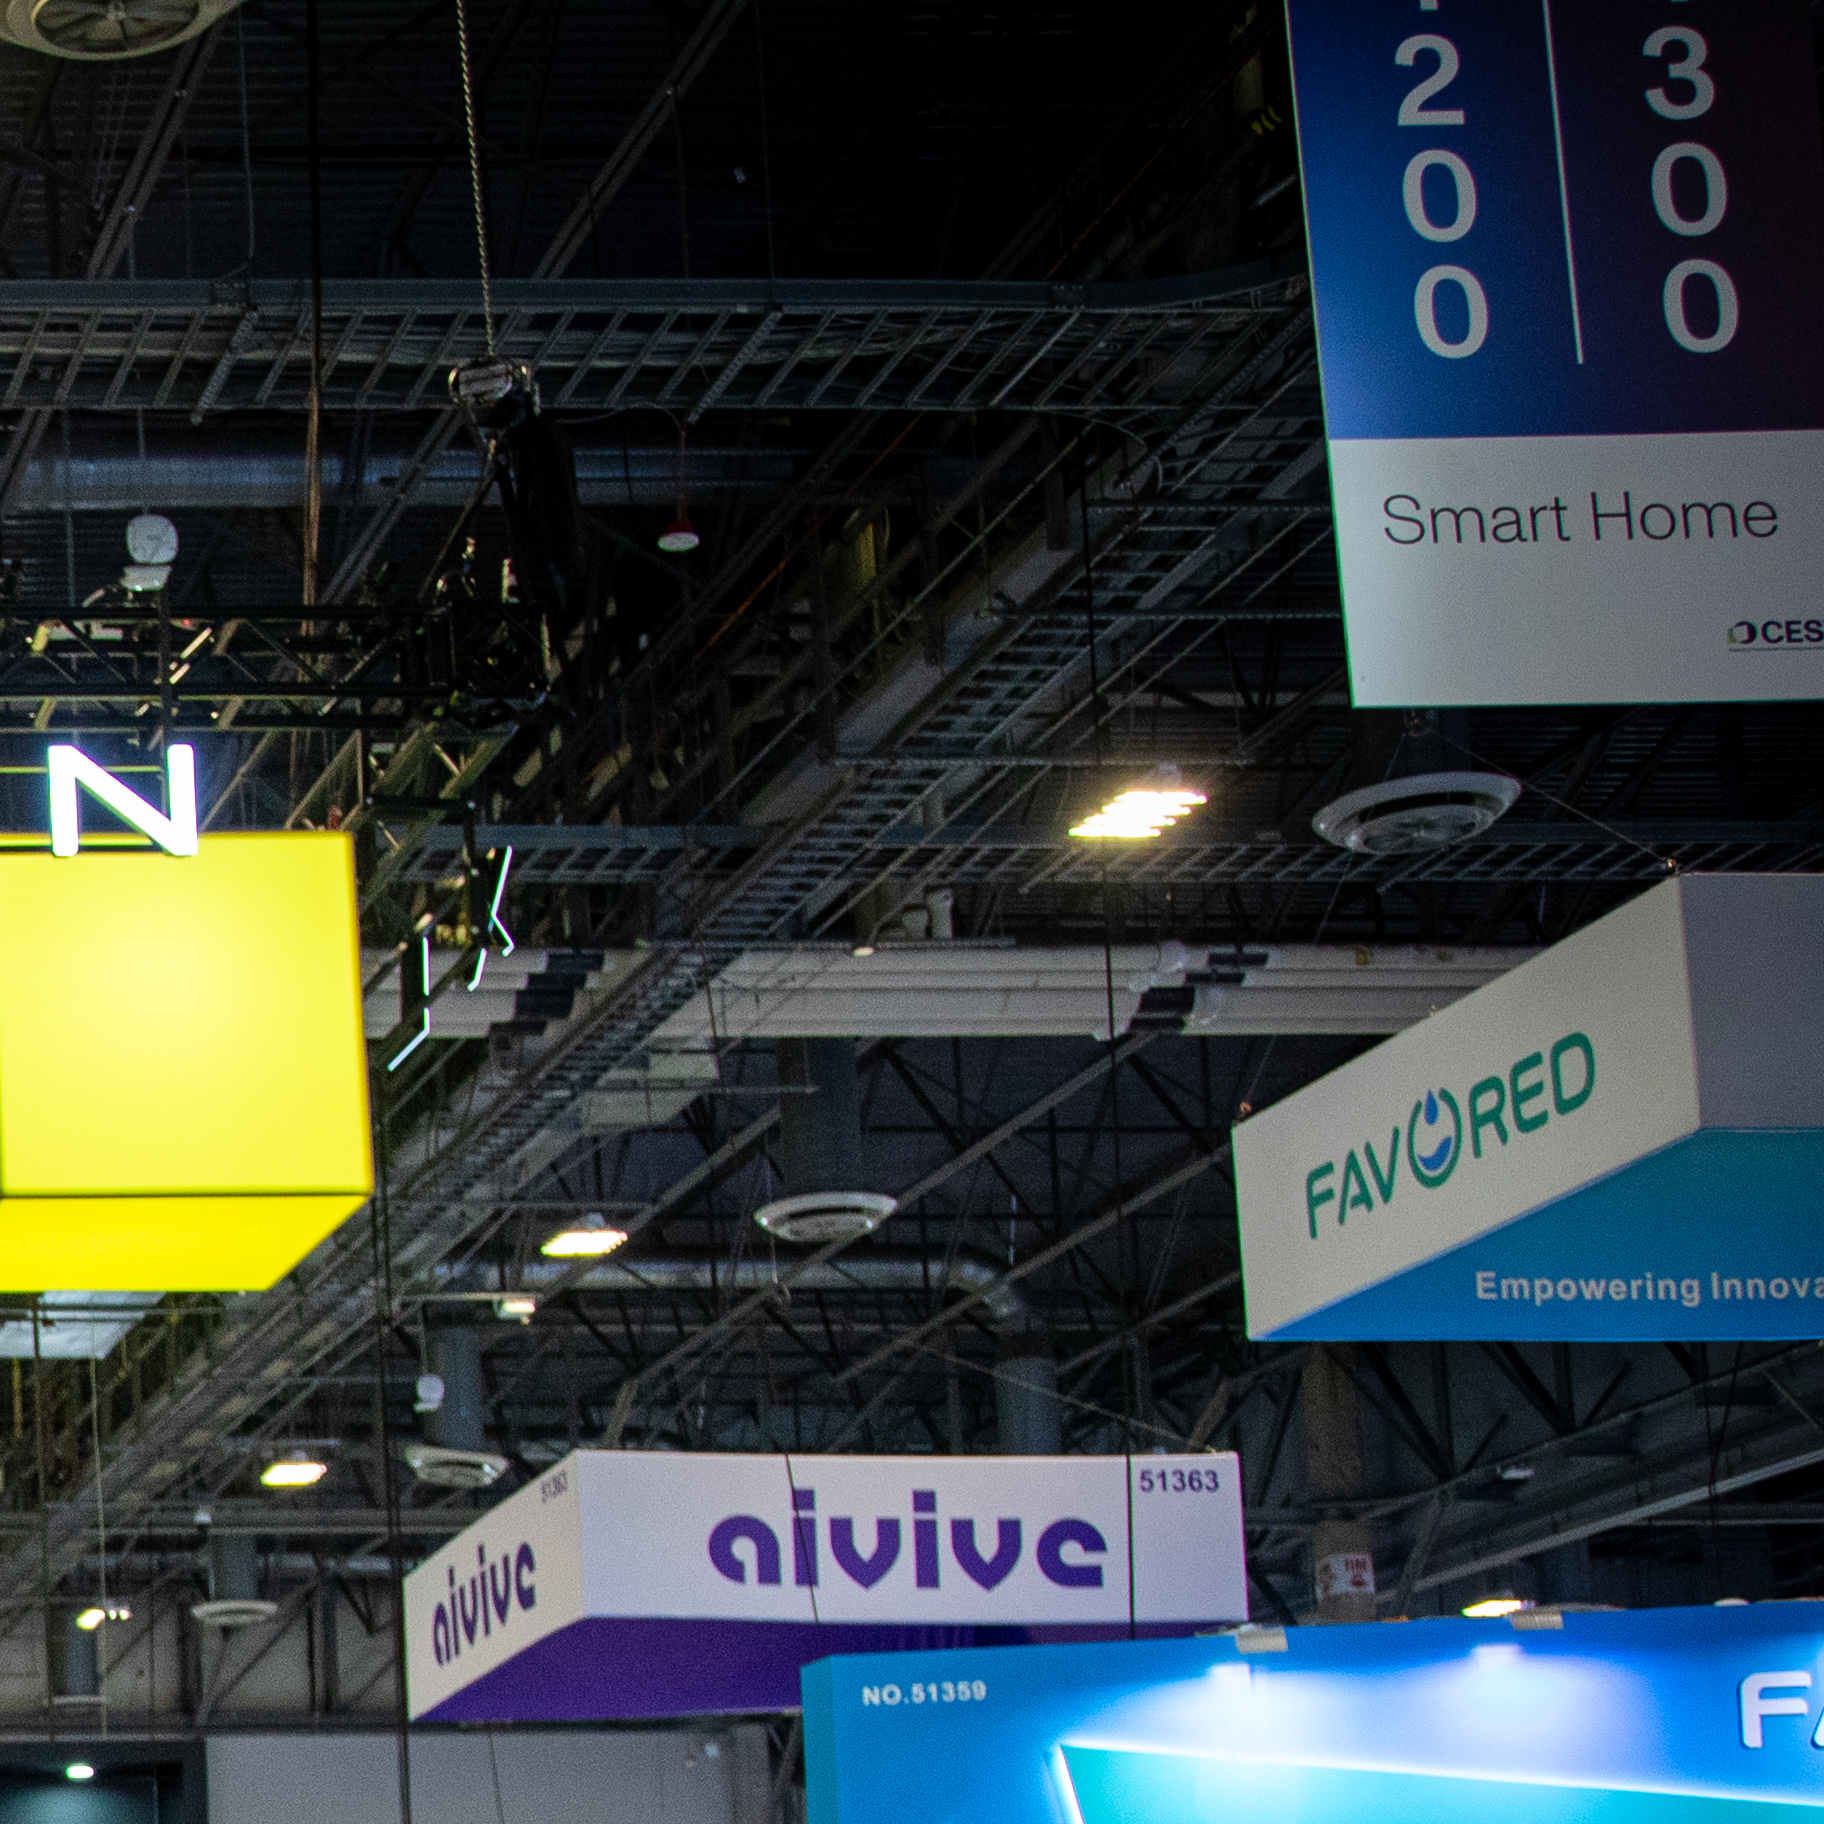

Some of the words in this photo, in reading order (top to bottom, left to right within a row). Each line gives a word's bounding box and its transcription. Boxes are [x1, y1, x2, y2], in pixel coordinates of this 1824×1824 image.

[1394, 0, 1489, 358] 200
[1383, 493, 1571, 545] Smart
[1591, 490, 1779, 541] Home
[1760, 619, 1824, 644] CES
[1305, 1031, 1596, 1240] FAVORED
[1475, 1270, 1701, 1308] Empowering
[1138, 1468, 1222, 1495] 51363
[707, 1488, 1109, 1592] aivive
[431, 1541, 537, 1668] aivive
[861, 1679, 989, 1709] NO.51359
